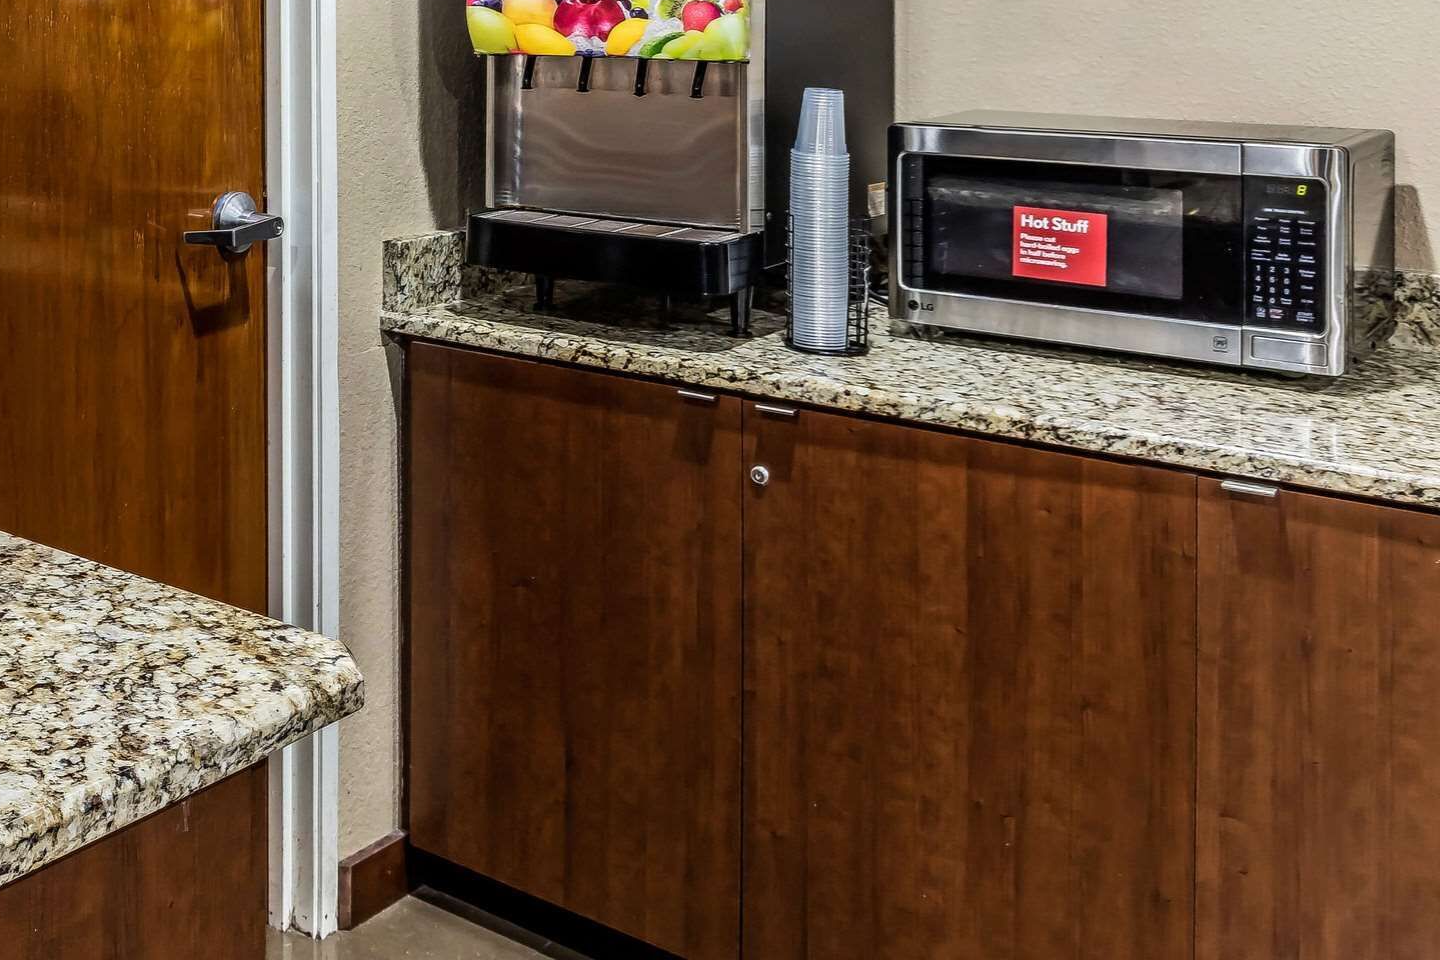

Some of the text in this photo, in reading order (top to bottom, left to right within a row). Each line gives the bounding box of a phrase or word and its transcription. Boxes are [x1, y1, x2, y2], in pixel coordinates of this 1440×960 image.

[1296, 184, 1308, 196] 8
[1020, 213, 1089, 233] Hot Stuff
[920, 302, 935, 311] LG
